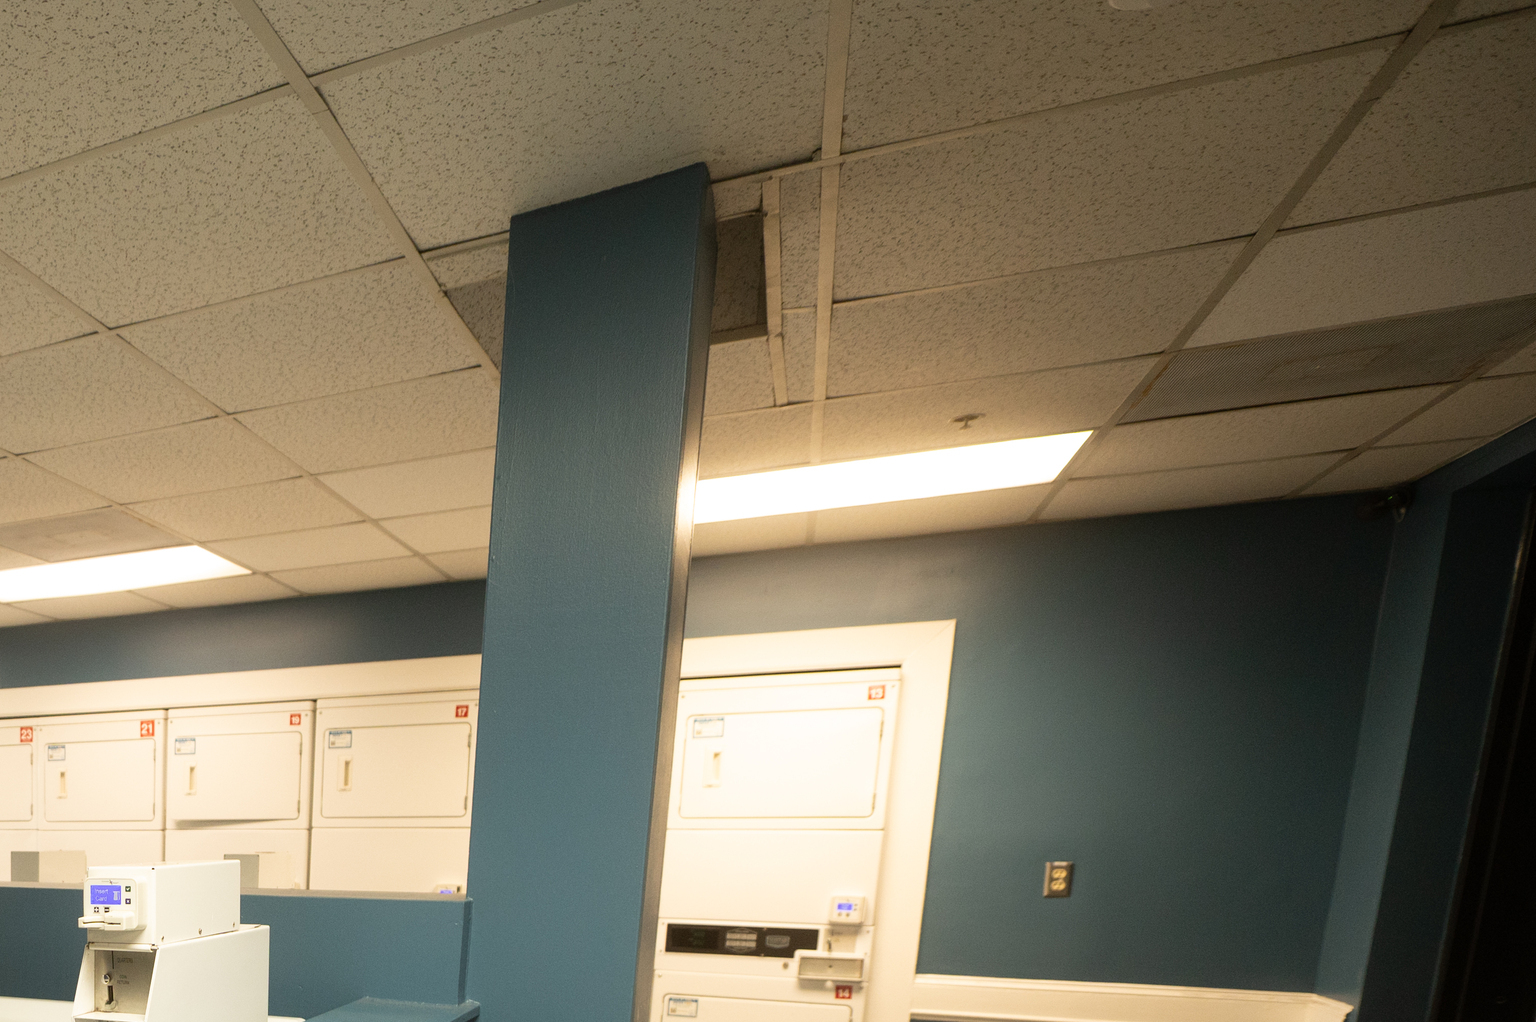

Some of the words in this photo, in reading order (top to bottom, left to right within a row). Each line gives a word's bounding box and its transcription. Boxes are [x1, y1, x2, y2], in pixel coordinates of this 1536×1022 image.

[457, 707, 467, 716] 17
[291, 716, 300, 724] 19
[141, 723, 153, 734] 21
[21, 728, 32, 740] 23
[838, 988, 850, 998] 14
